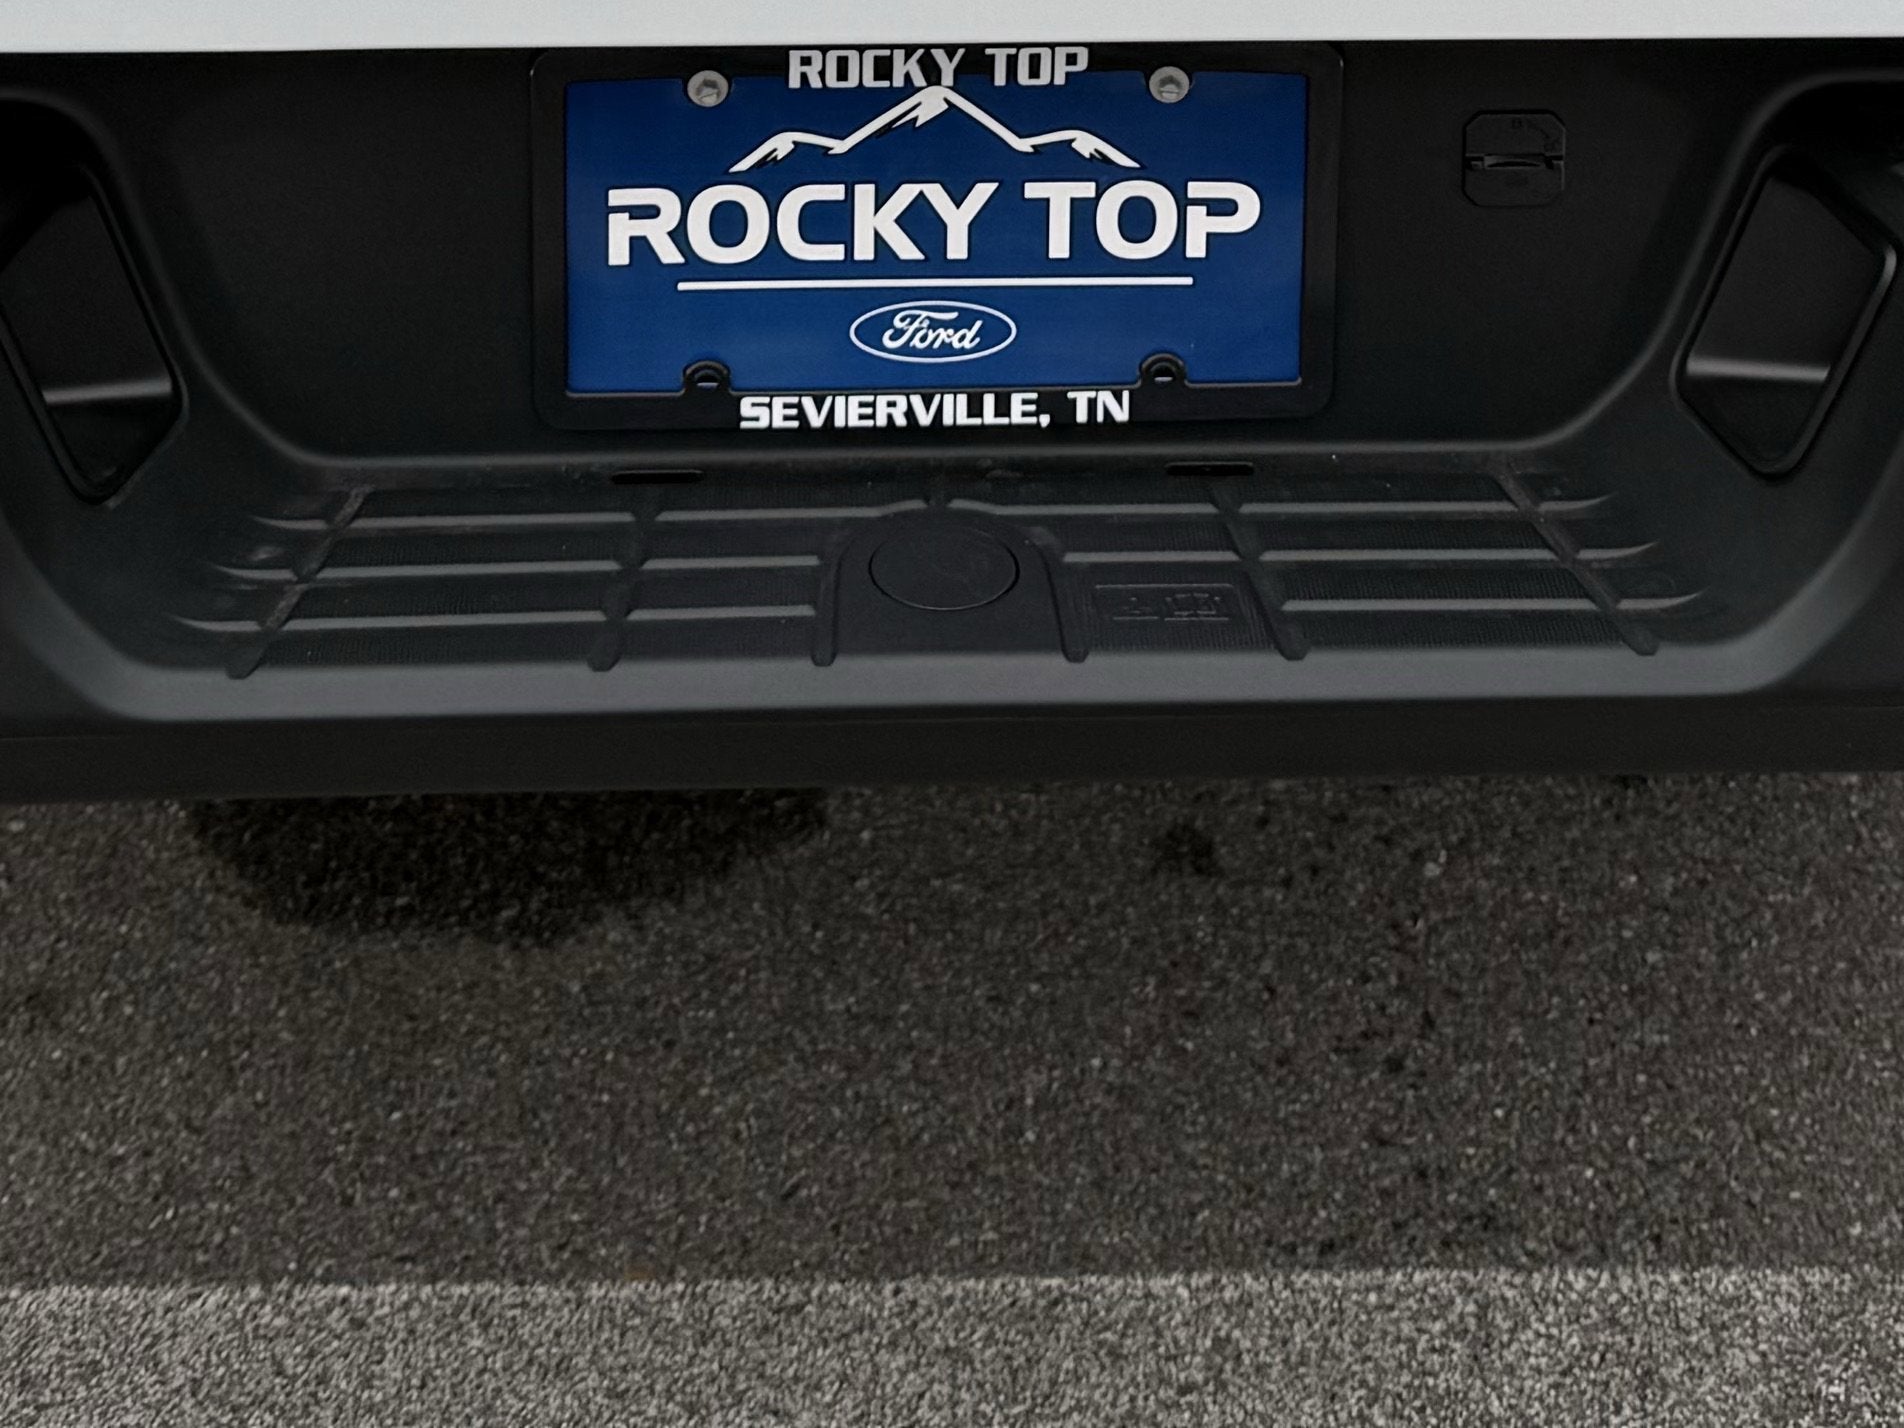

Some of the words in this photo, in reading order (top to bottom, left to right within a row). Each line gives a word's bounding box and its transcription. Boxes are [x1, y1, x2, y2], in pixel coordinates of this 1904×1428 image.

[789, 48, 965, 88] ROCKY
[985, 46, 1088, 86] TOP
[608, 182, 998, 266] ROCKY
[1024, 181, 1261, 261] TOP
[882, 310, 984, 350] Ford
[739, 392, 1052, 430] SEVIERVILLE,
[1068, 390, 1131, 424] TN
